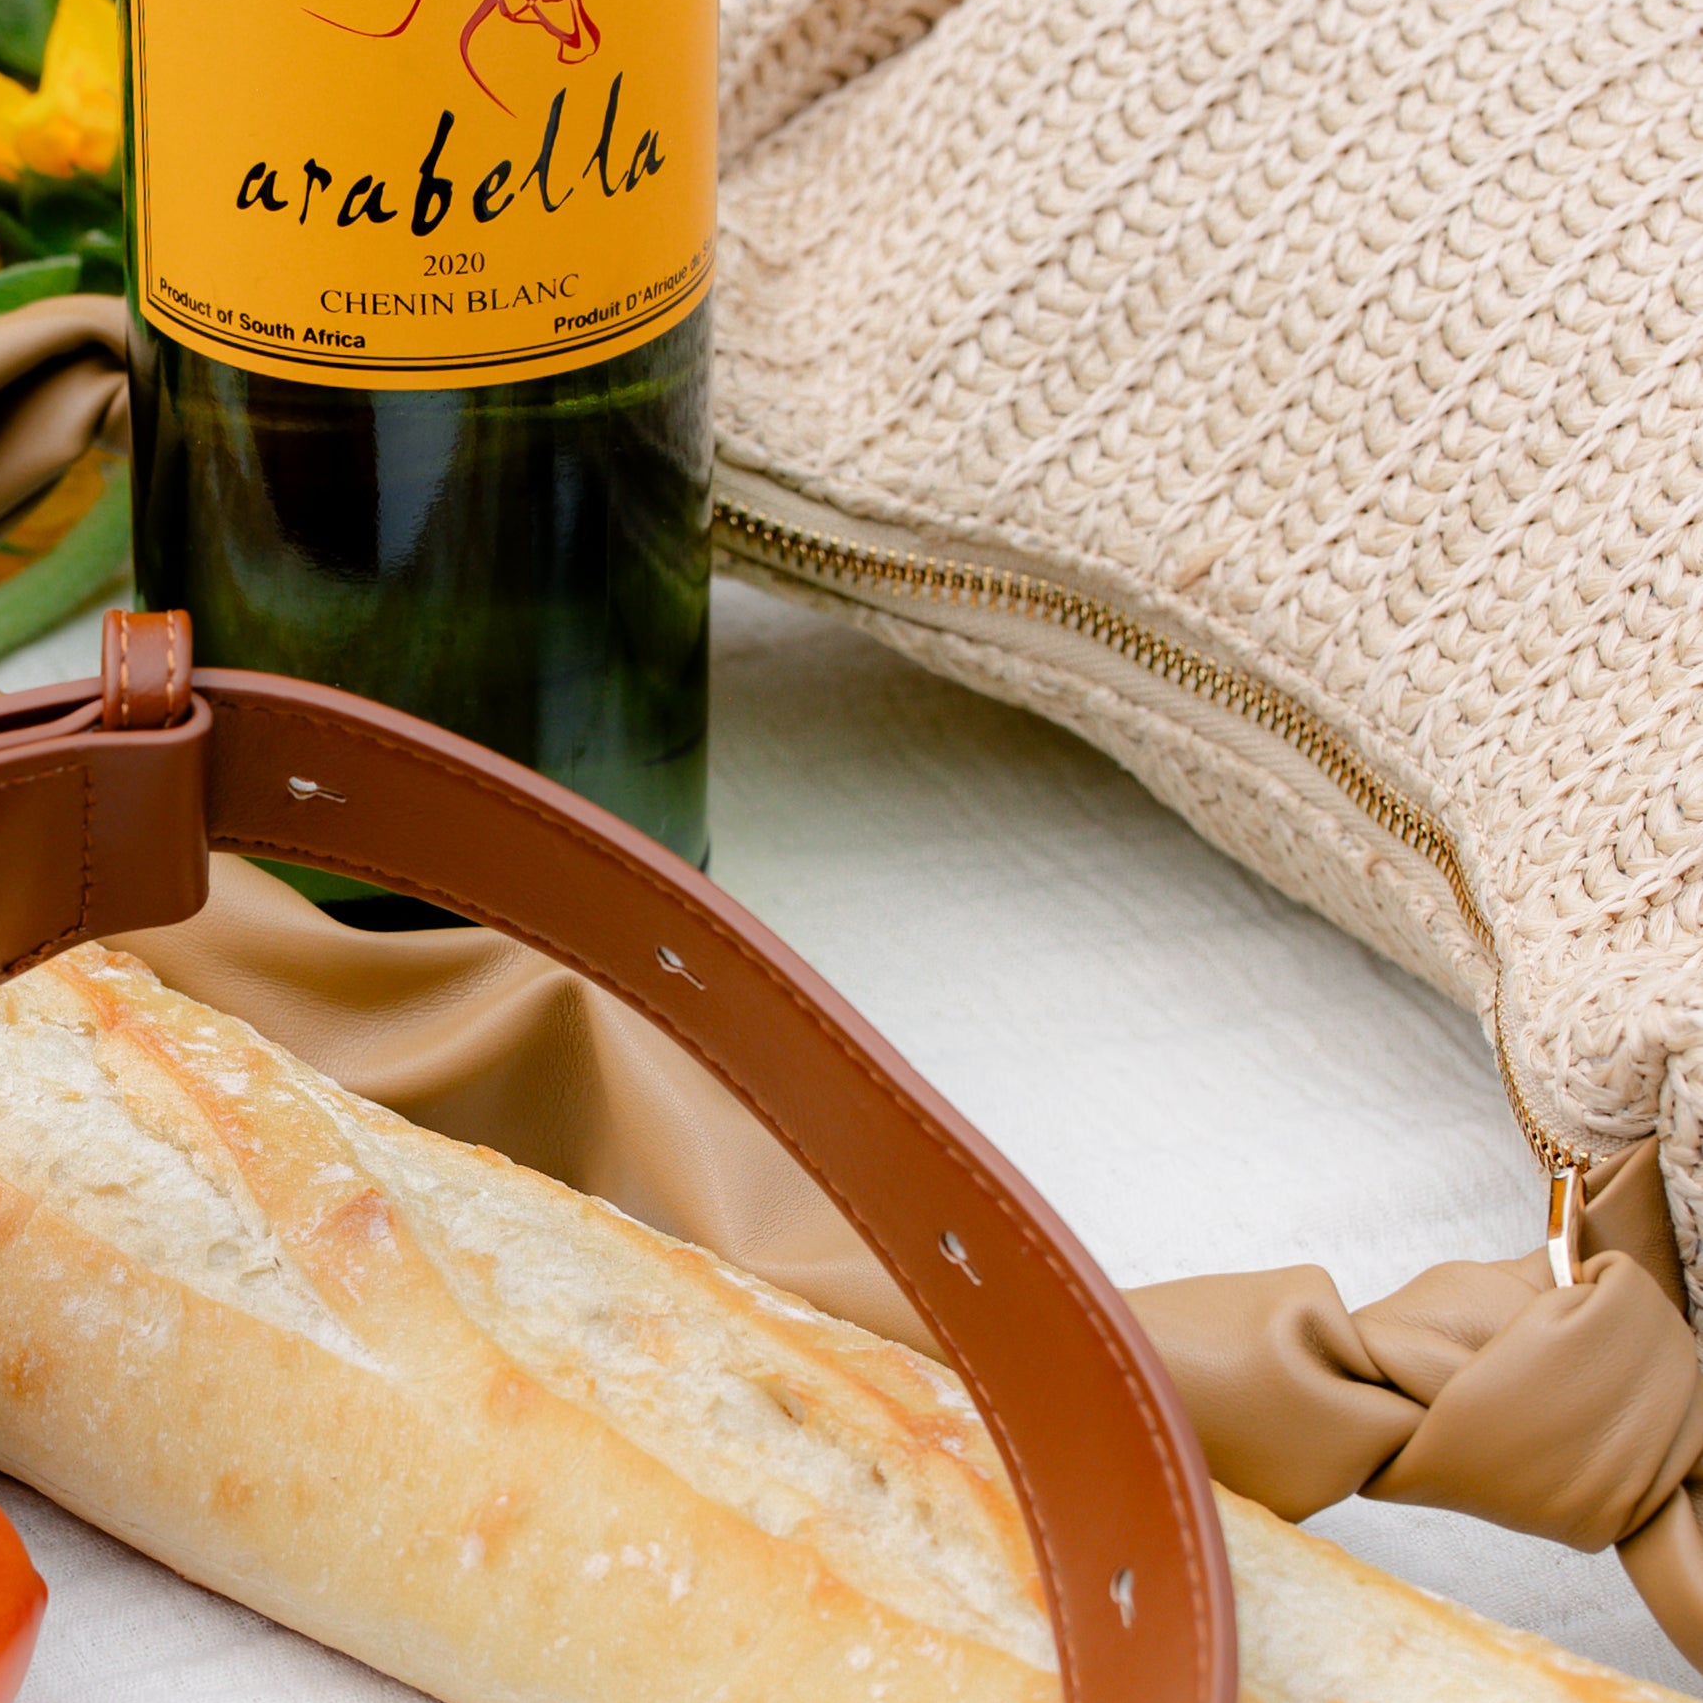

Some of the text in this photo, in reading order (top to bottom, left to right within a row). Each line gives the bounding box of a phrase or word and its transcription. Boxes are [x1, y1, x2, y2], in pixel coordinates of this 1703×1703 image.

[236, 71, 666, 237] arabella
[320, 273, 580, 316] CHENIN BLANC
[423, 251, 485, 277] 2020
[160, 277, 367, 349] Product of South Africa
[554, 302, 621, 335] Produit
[626, 266, 689, 313] D'Afrique
